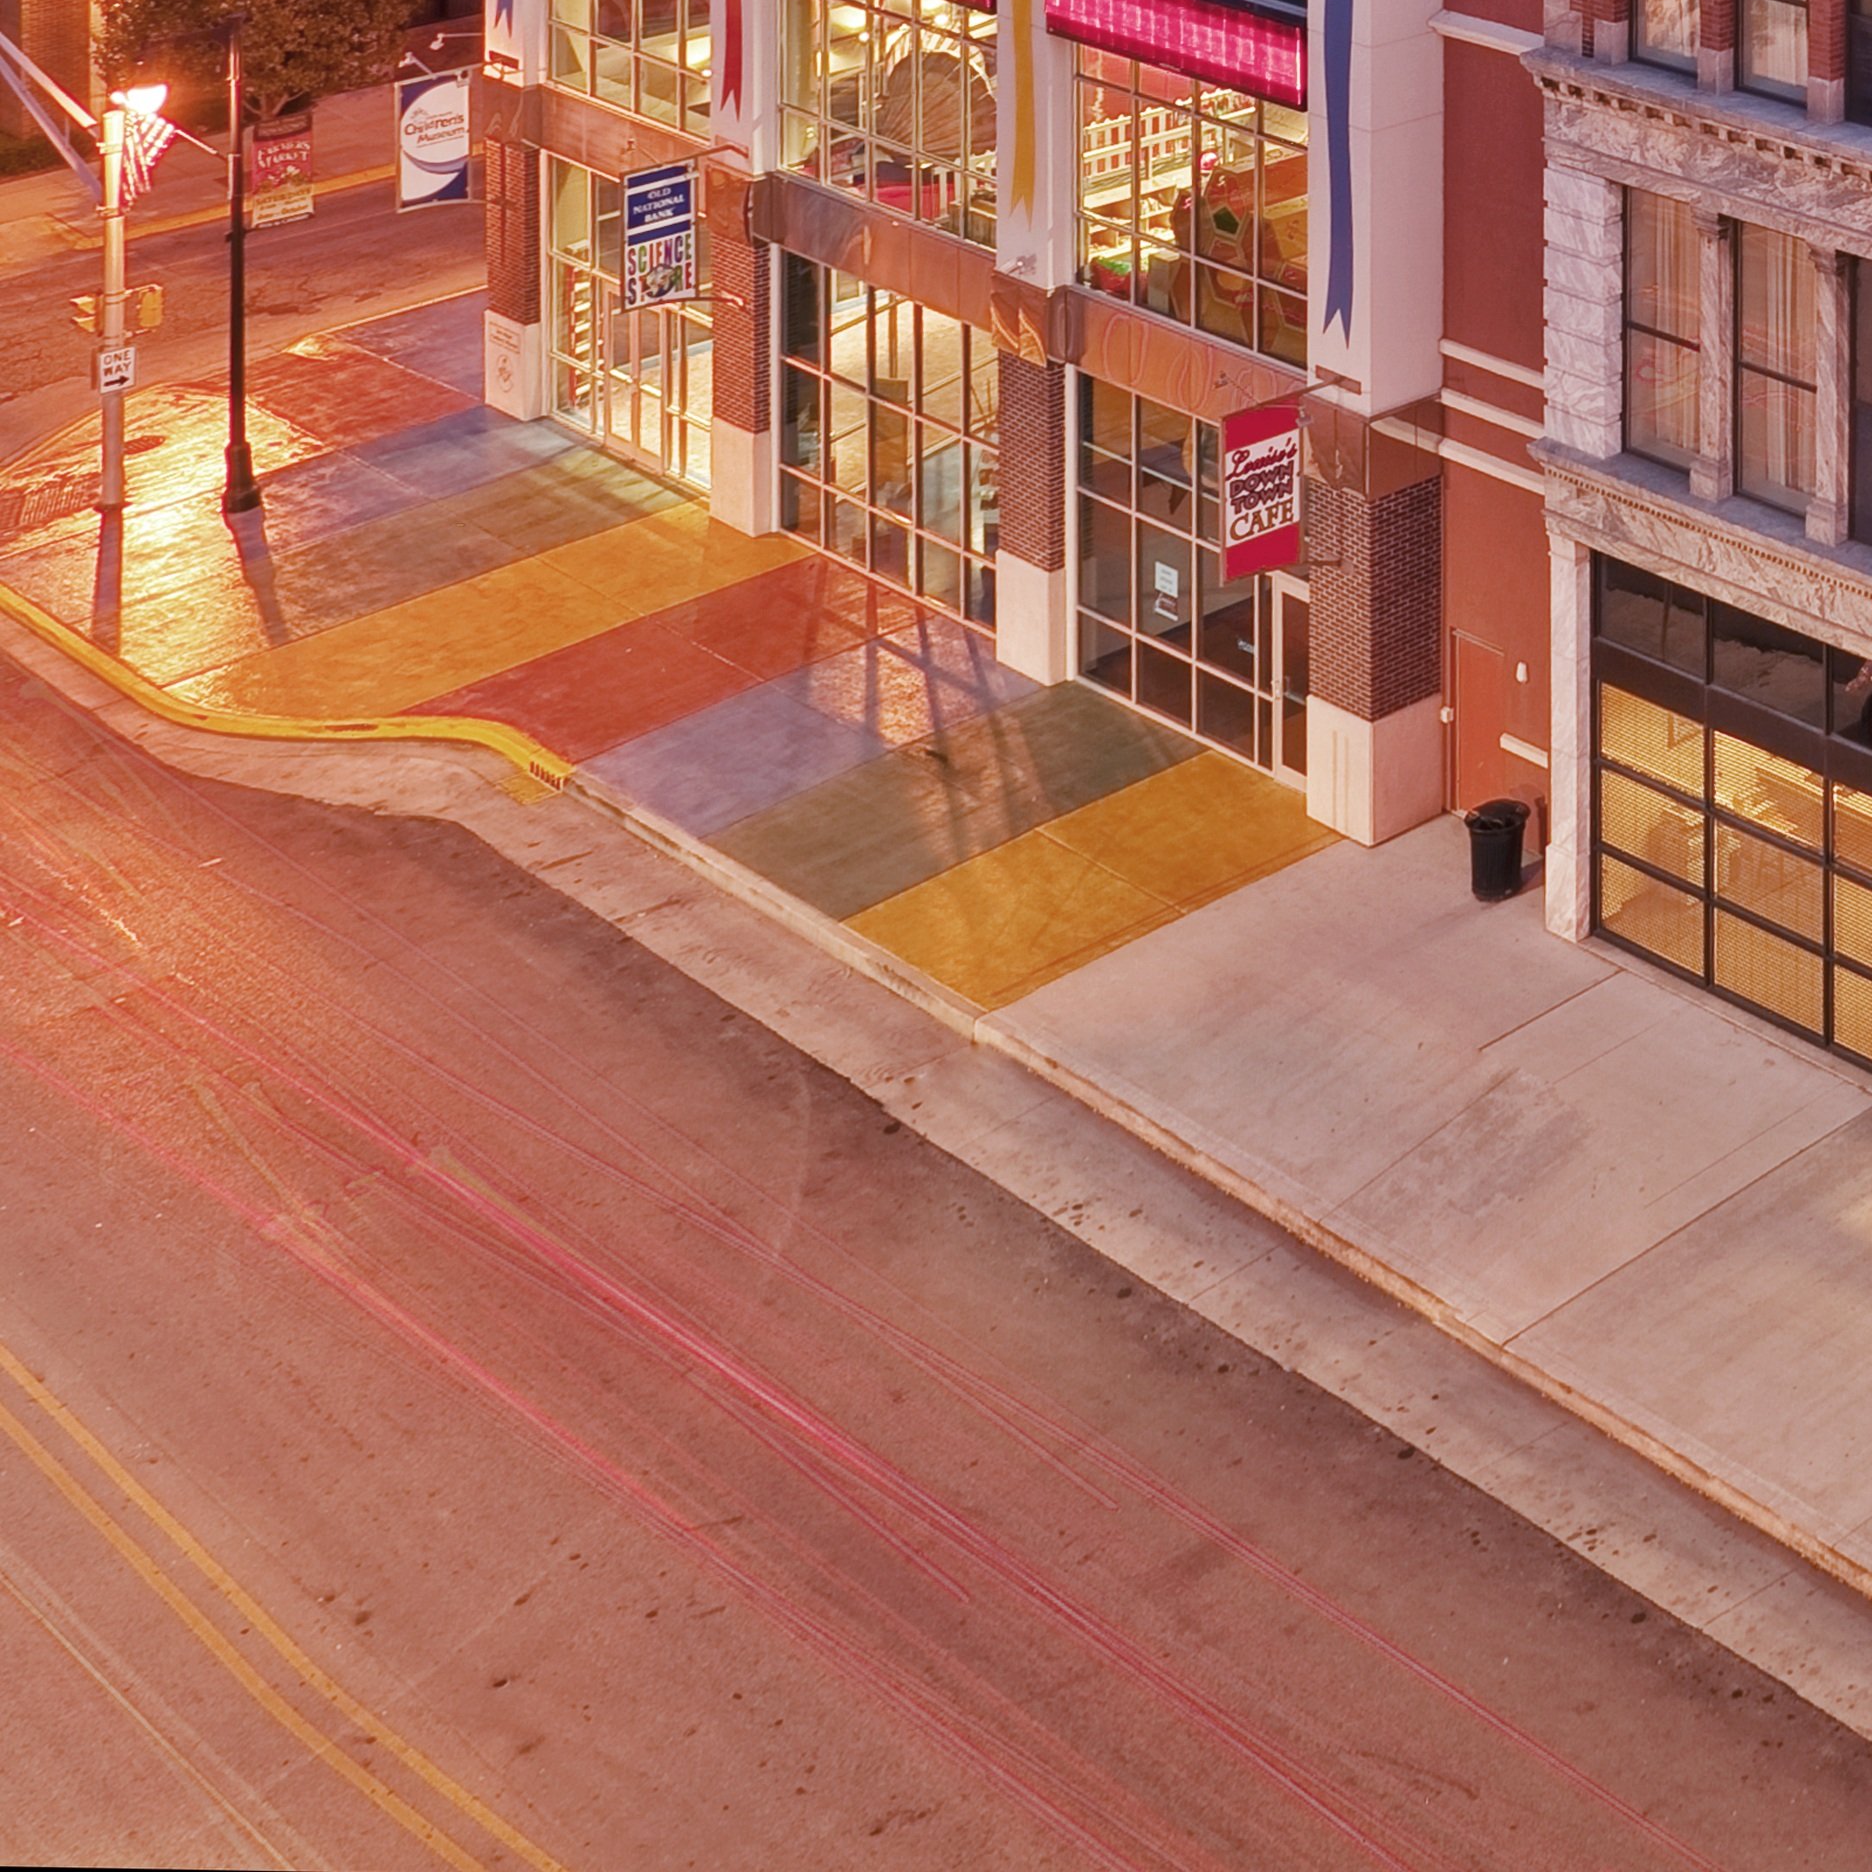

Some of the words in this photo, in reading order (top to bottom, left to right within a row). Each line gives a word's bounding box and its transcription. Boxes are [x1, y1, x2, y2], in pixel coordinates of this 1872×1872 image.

[646, 187, 672, 200] OLD
[632, 194, 685, 215] NATIONAL
[644, 207, 676, 223] BANK
[627, 233, 692, 276] SCIENCE
[103, 349, 131, 366] ONE
[103, 361, 132, 377] WAY
[1229, 460, 1295, 499] DOWN
[1230, 479, 1294, 515] TOWN
[1229, 496, 1294, 541] CAFE
